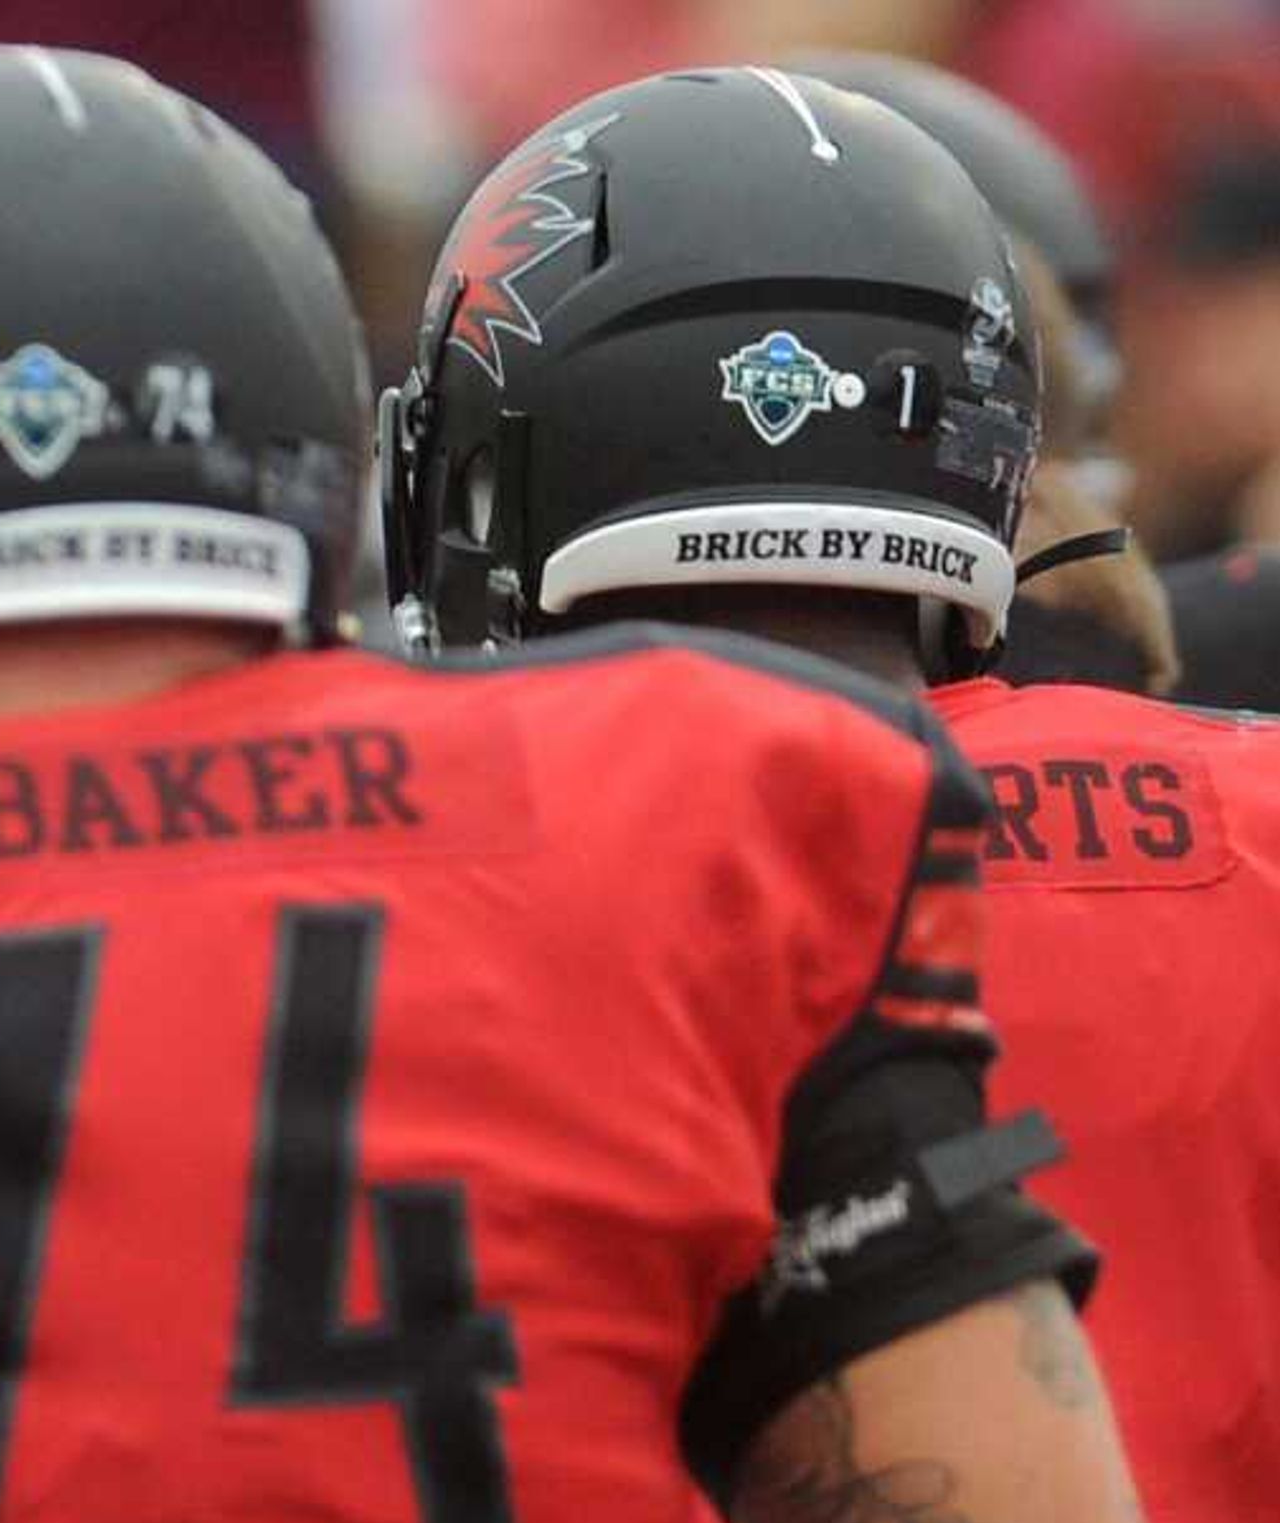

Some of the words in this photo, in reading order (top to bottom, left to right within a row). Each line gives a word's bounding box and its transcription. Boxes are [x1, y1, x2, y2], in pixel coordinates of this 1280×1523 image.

[147, 363, 214, 446] 74
[104, 526, 157, 565] BY
[675, 528, 811, 564] BRICK
[819, 528, 873, 561] BY
[881, 533, 979, 586] BRICK
